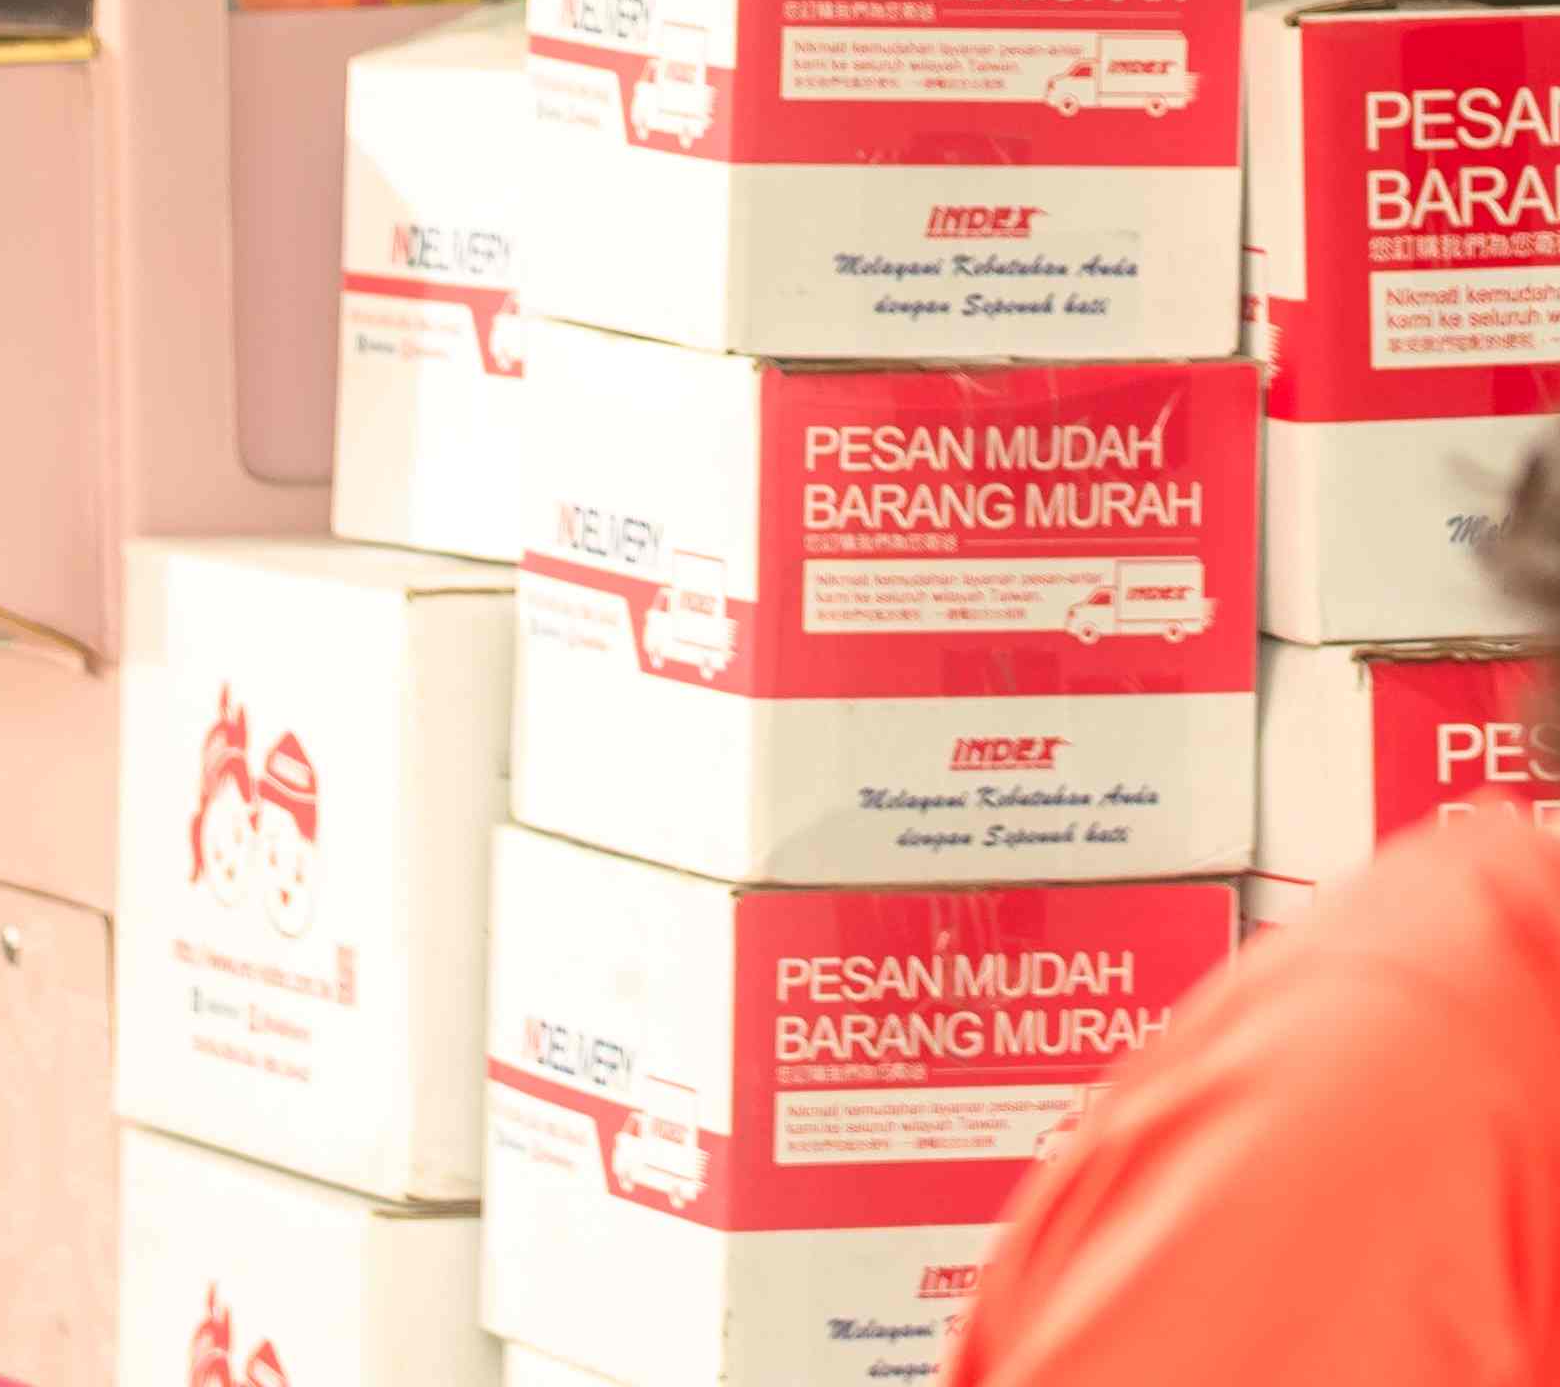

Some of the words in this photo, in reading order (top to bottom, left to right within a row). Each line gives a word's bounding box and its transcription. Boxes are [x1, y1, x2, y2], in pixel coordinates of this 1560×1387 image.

[927, 203, 1051, 232] INDEX
[1385, 287, 1459, 308] Nikmati
[1441, 310, 1463, 328] ke
[1469, 308, 1540, 328] seluruh
[803, 425, 973, 472] PESAN
[986, 425, 1162, 471] MUDAH
[802, 484, 1015, 530] BARANG
[1025, 482, 1202, 529] MURAH
[952, 735, 1075, 764] INDEX
[775, 956, 943, 1002] PESAN
[953, 951, 1134, 999] MUDAH
[775, 1011, 987, 1062] BARANG
[995, 1008, 1171, 1056] MURAH
